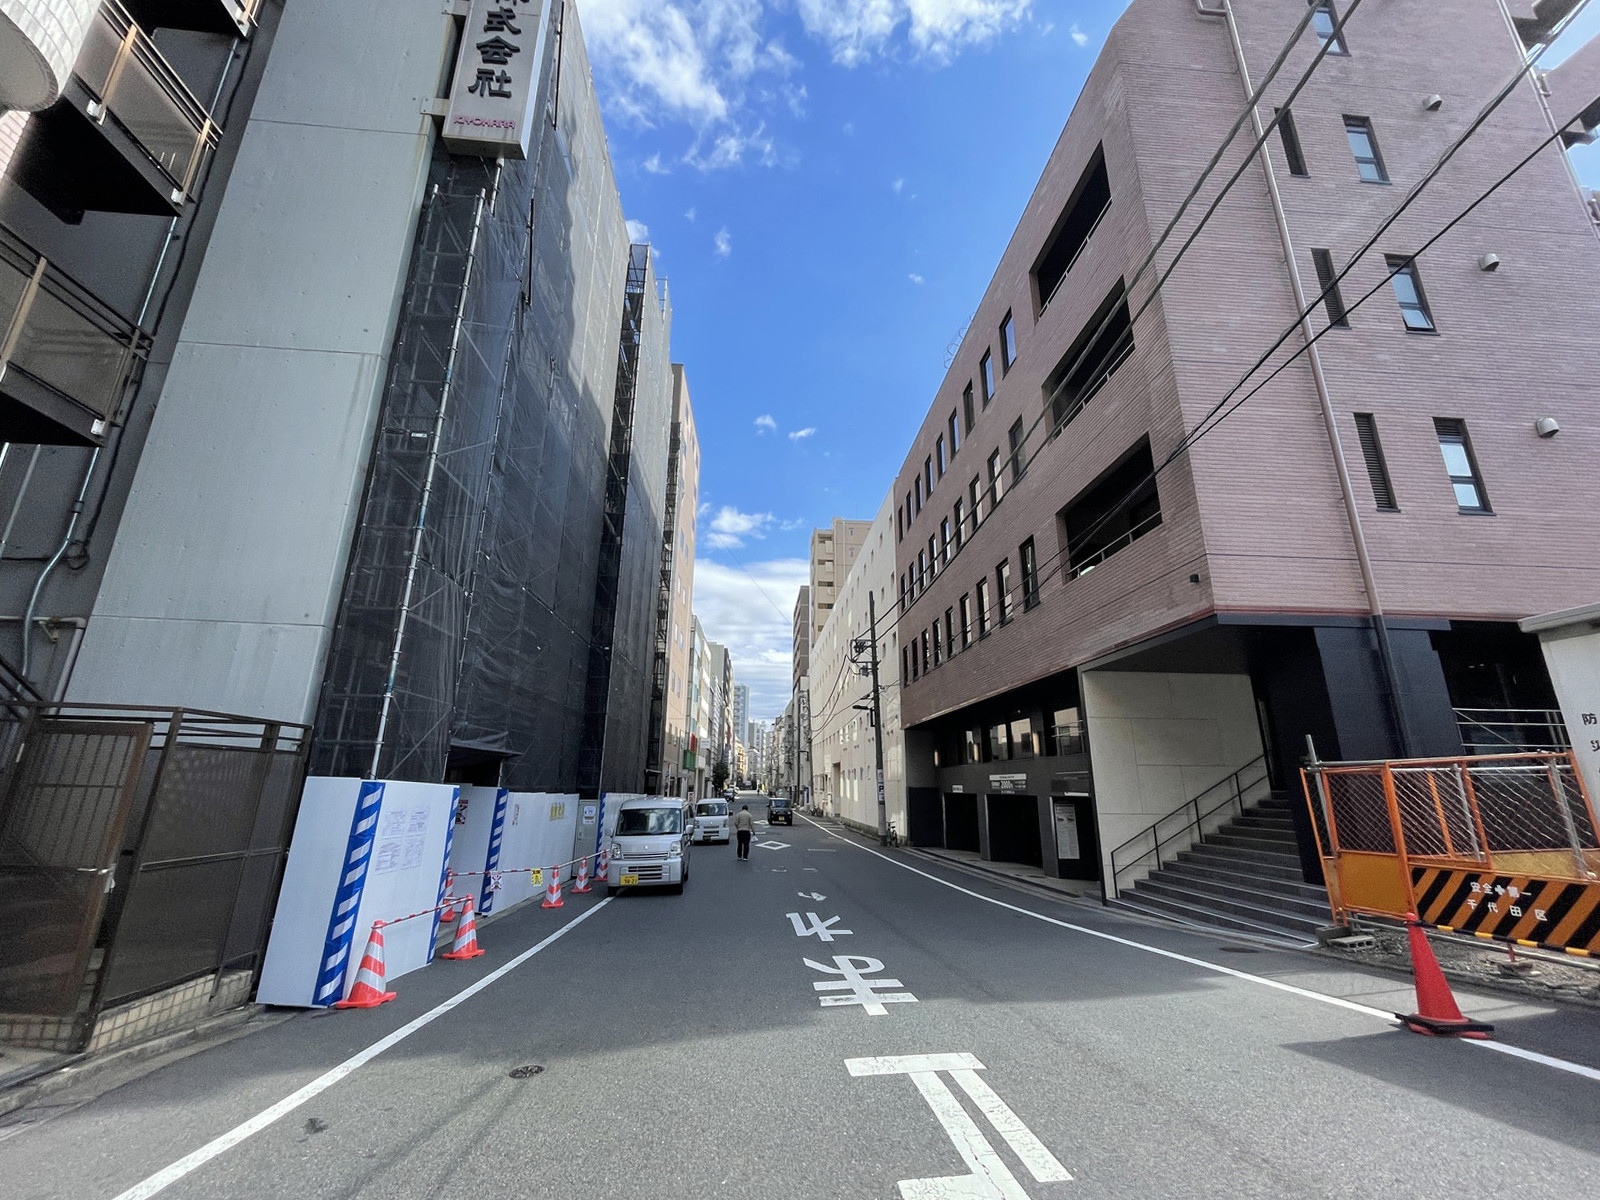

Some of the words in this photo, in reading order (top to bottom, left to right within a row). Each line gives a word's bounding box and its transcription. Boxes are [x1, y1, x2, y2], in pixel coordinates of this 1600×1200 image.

[468, 0, 530, 98] 式会社
[1467, 899, 1548, 921] 千代田区
